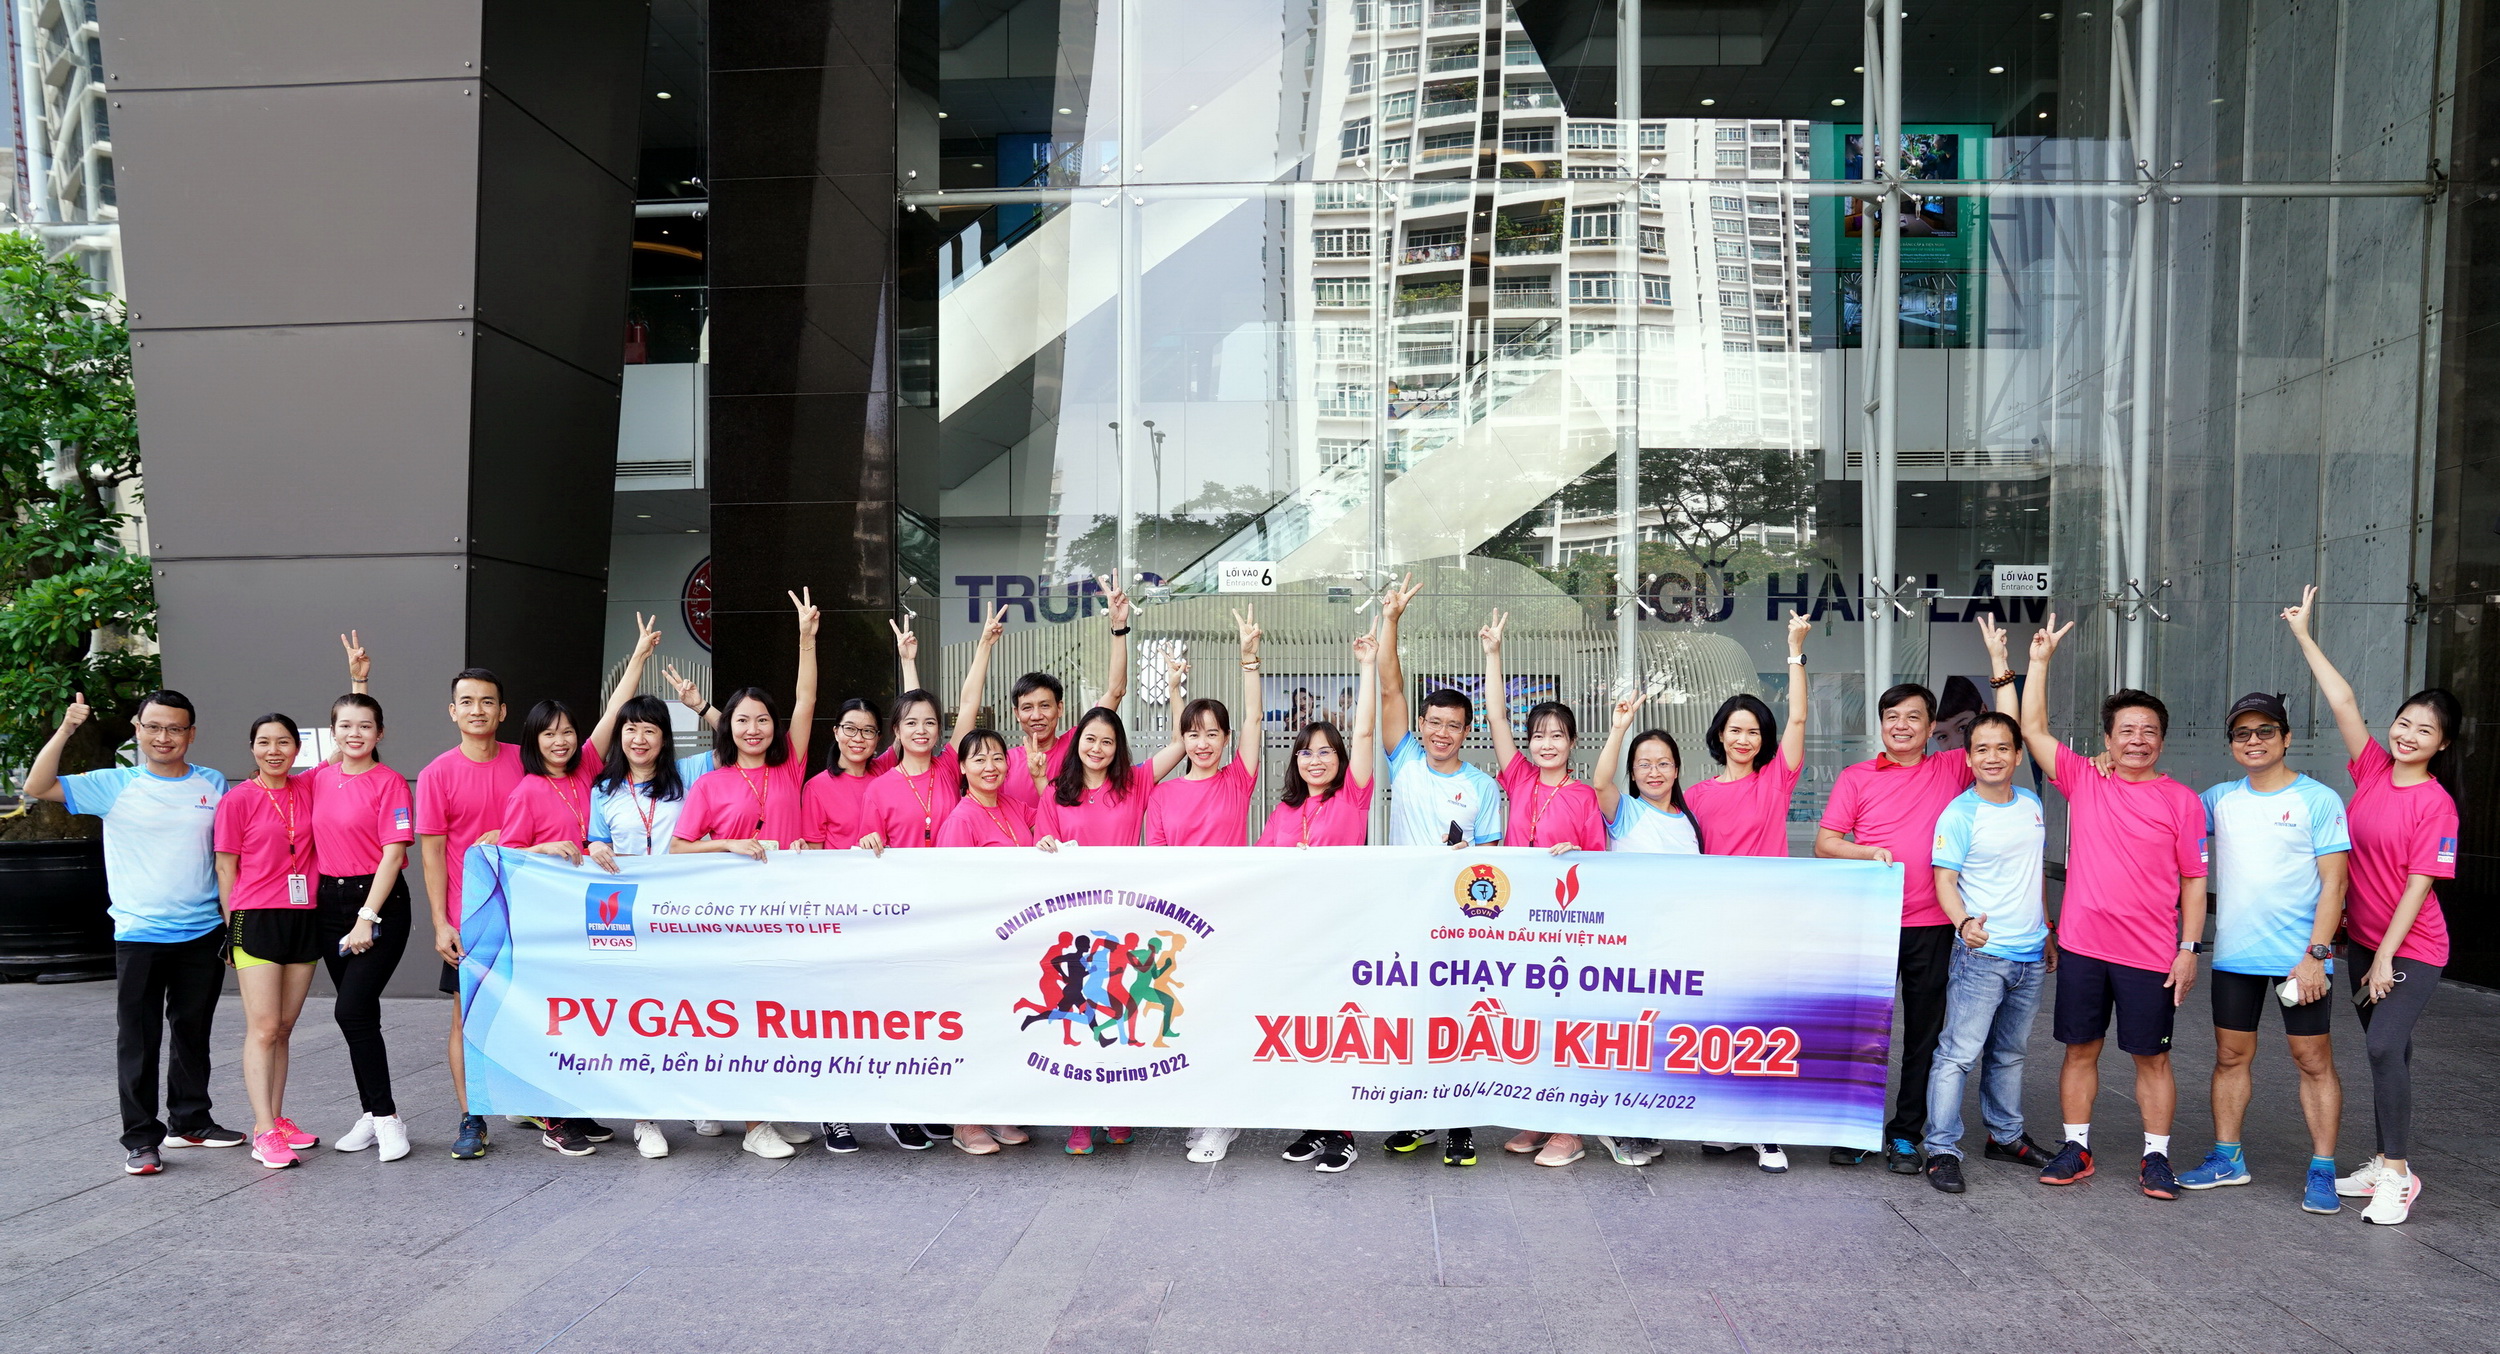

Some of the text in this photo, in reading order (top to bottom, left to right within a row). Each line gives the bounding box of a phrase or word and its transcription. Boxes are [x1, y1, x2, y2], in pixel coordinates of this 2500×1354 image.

[1226, 566, 1273, 587] LỐI VÀO 6
[1226, 579, 1259, 587] Entrance
[2001, 570, 2048, 591] LỐI VÀO 5
[2001, 583, 2034, 591] Entrance
[694, 902, 734, 916] CÔNG
[740, 904, 757, 916] TY
[760, 901, 785, 916] KHÍ
[789, 901, 821, 919] VIỆT
[825, 904, 858, 916] NAM
[872, 903, 911, 916] CTCP
[995, 889, 1215, 941] ONLINE RUNNING TOURNAMENT
[1529, 908, 1605, 924] PETROVIETNAM
[588, 922, 632, 931] PETROVIETNAM
[650, 922, 841, 934] FUELLING VALUES TO LIFE
[1430, 926, 1627, 947] CÔNG ĐOÀN DẦU KHÍ VIỆT NAM
[592, 938, 633, 947] PV GAS
[1352, 951, 1704, 998] GIẢI CHẠY BỘ ONLINE
[546, 997, 964, 1041] PV GAS Runners
[1252, 998, 1801, 1078] XUÂN DẦU KHÍ 2022
[619, 1052, 656, 1076] mẽ,
[662, 1050, 699, 1073] bền
[704, 1052, 724, 1074] bỉ
[729, 1054, 770, 1074] như
[773, 1055, 823, 1078] dòng
[828, 1056, 863, 1075] Khí
[868, 1058, 891, 1079] tự
[1026, 1051, 1190, 1084] Oil & Gas Spring 2022
[1351, 1081, 1697, 1110] Thời gian: từ 06/4/2022 đến ngày 16/4/2022
